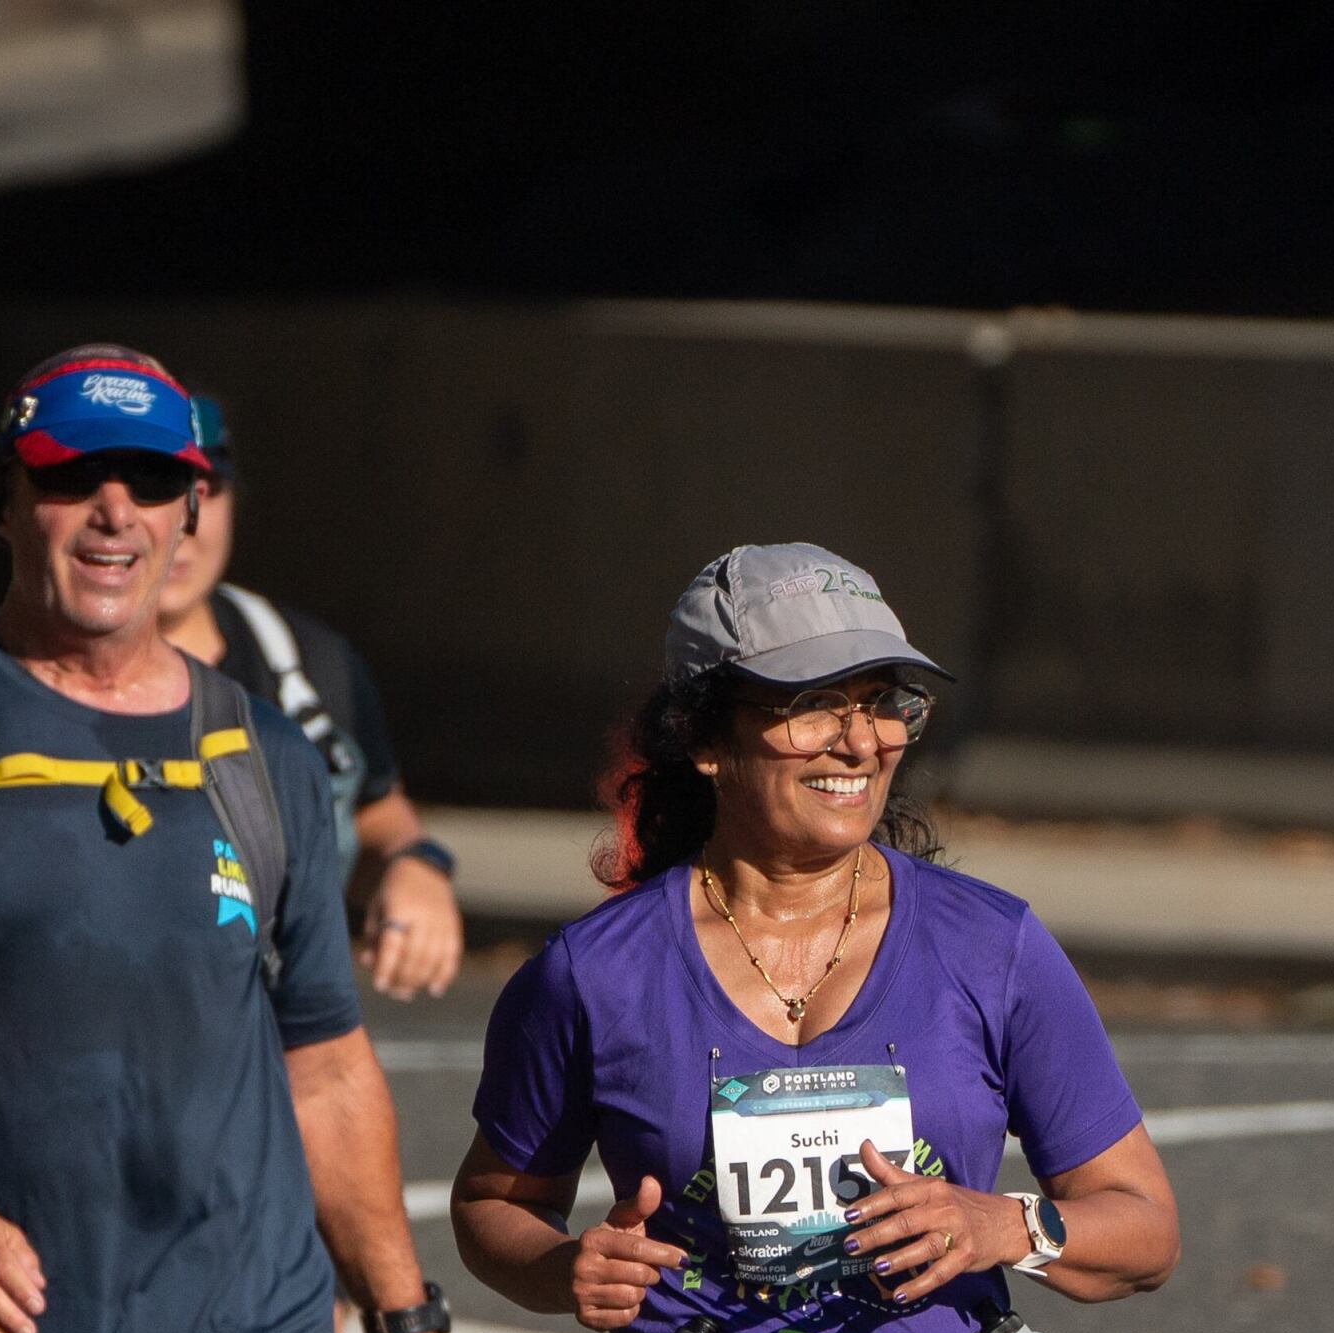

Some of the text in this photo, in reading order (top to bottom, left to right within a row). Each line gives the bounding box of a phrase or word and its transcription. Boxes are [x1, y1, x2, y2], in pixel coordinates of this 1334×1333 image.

[80, 374, 150, 396] Brazen
[91, 387, 157, 415] Racing
[815, 567, 860, 593] 25
[784, 1071, 856, 1085] PORTLAND
[785, 1080, 857, 1091] MARATHON
[791, 1130, 839, 1148] Suchi
[738, 1244, 787, 1258] skratch
[769, 1264, 787, 1273] FOR
[842, 1262, 875, 1276] BEER
